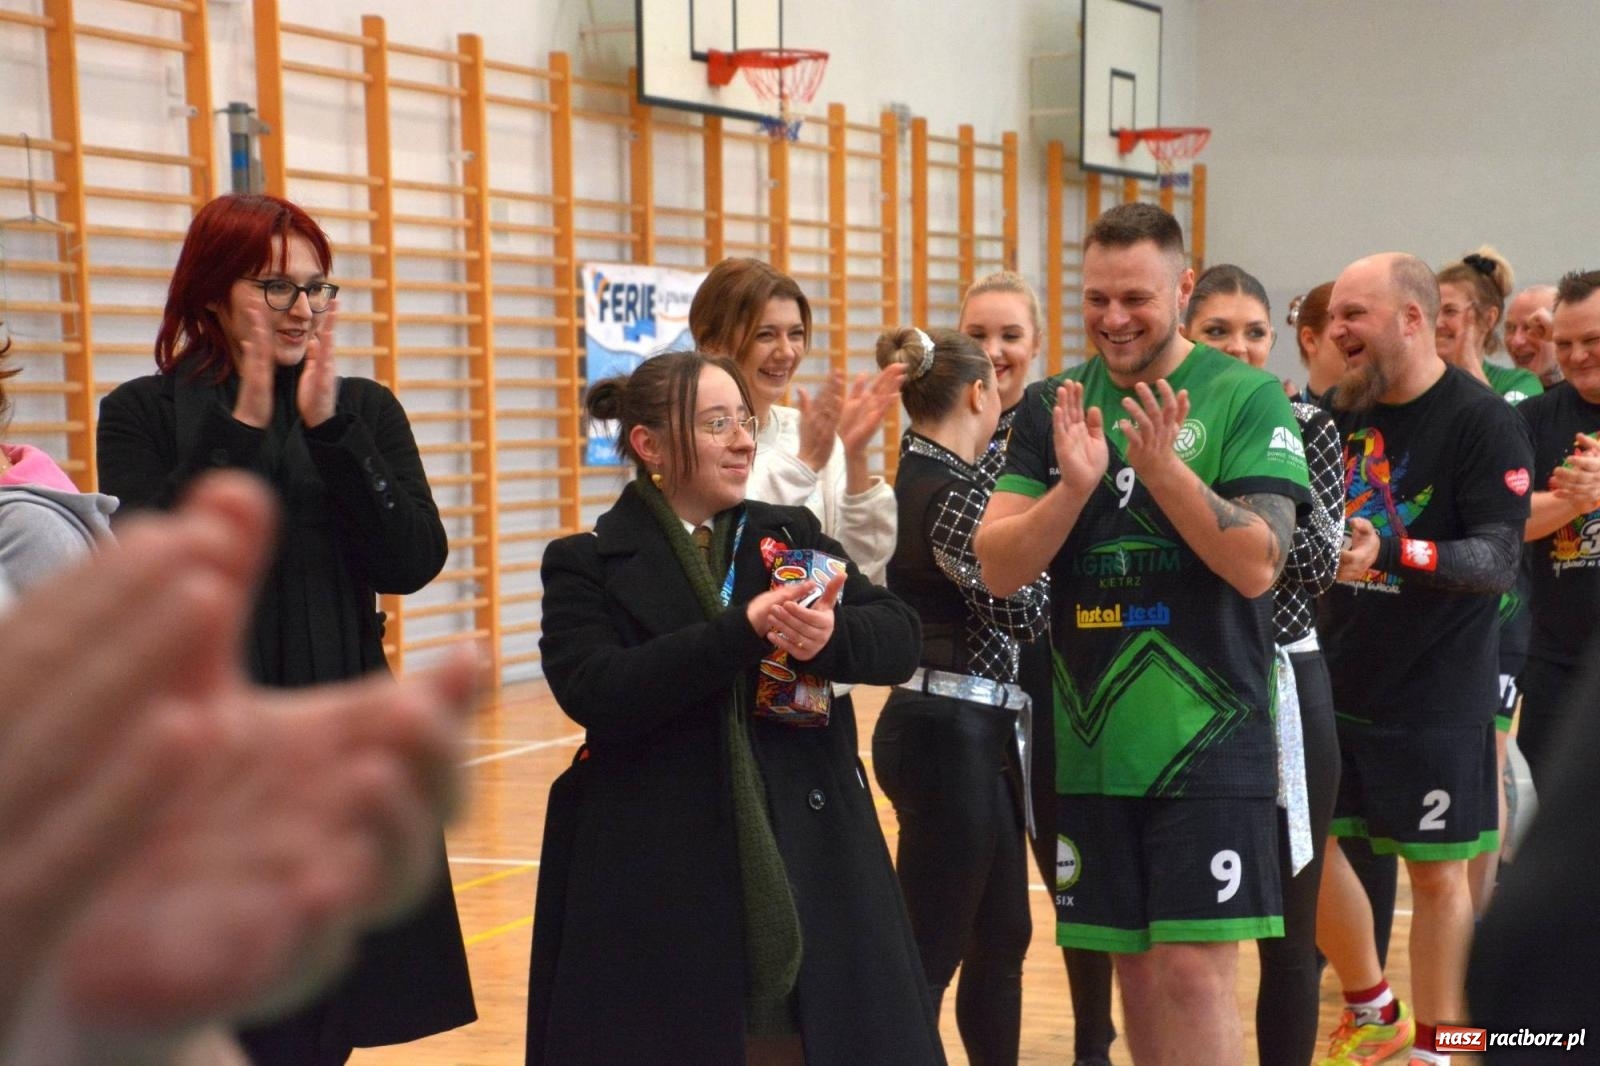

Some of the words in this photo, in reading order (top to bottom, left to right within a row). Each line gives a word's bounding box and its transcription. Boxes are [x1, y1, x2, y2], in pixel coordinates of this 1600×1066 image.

[598, 283, 656, 323] FERIE
[1116, 467, 1136, 509] 9
[1419, 789, 1451, 831] 2
[1210, 849, 1242, 904] 9
